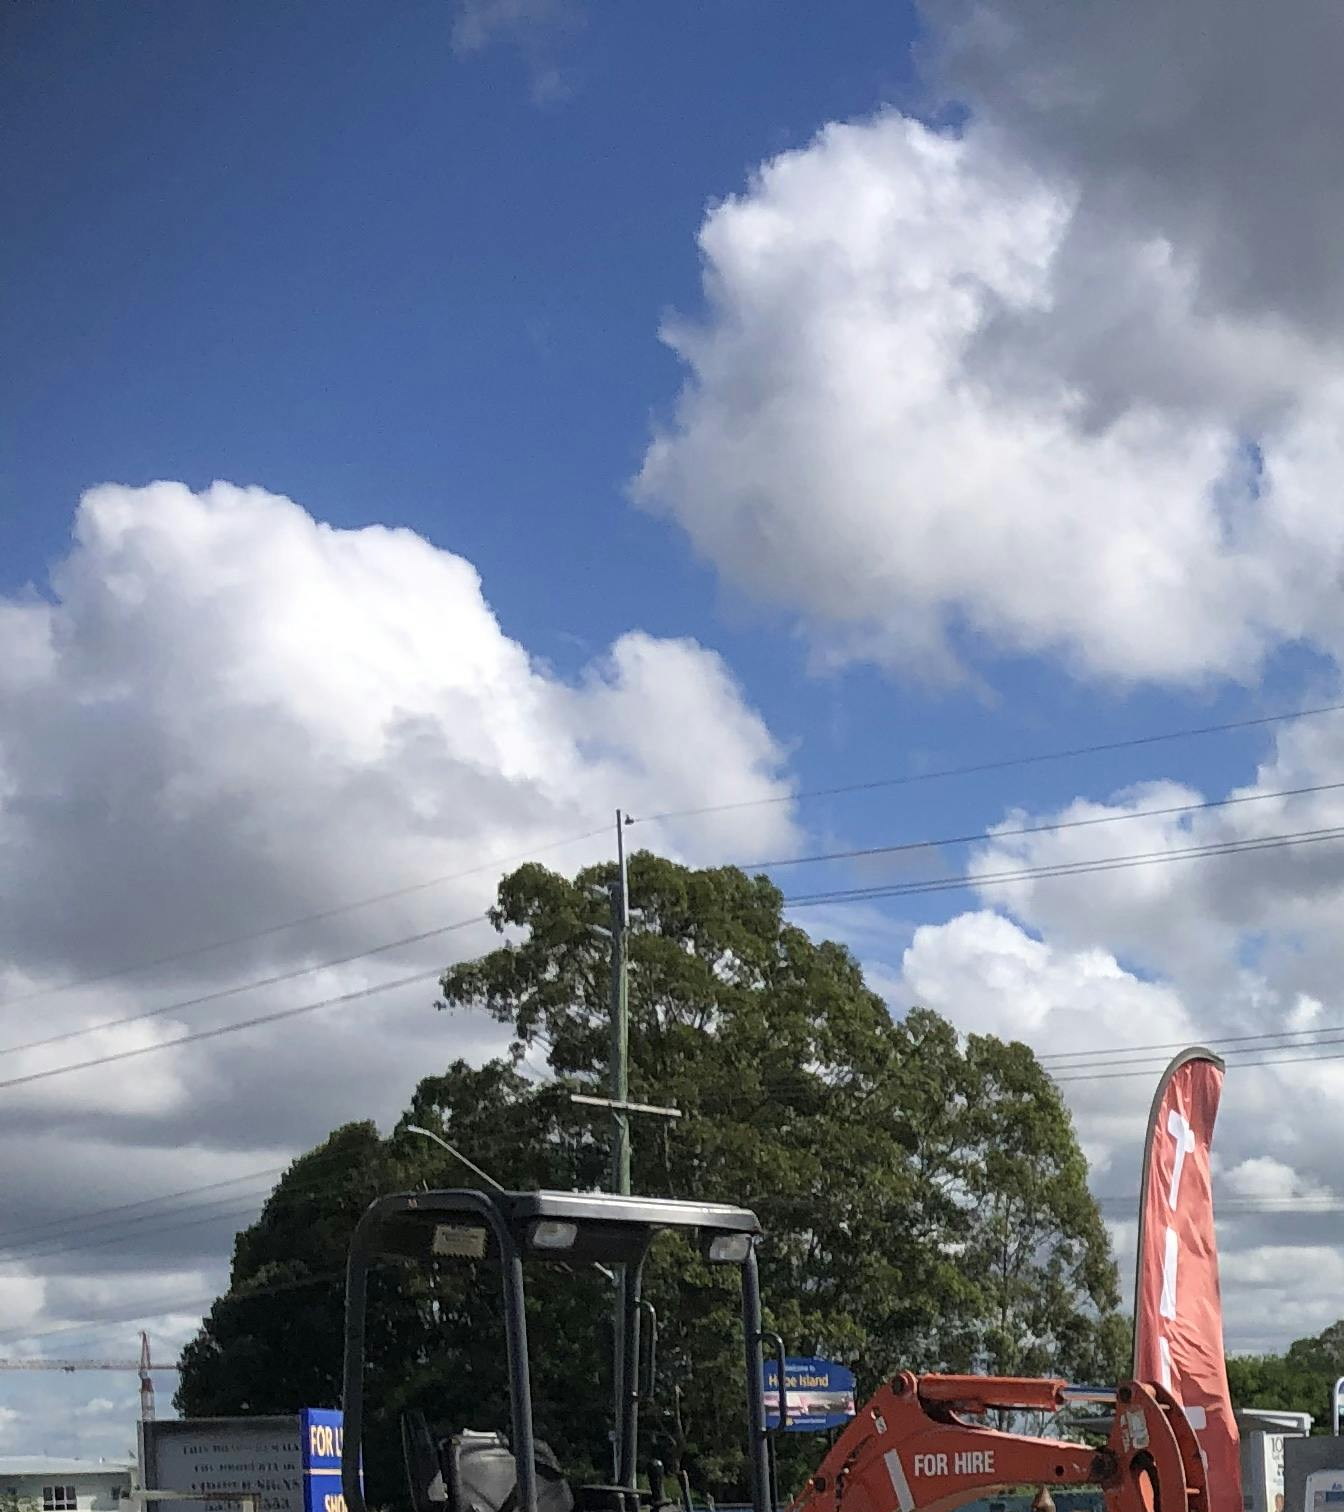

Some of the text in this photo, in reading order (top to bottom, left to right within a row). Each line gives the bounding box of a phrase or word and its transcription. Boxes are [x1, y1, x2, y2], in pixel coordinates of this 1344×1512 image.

[800, 1373, 828, 1387] Island
[310, 1425, 333, 1457] FOR
[914, 1450, 995, 1477] FOR HIRE
